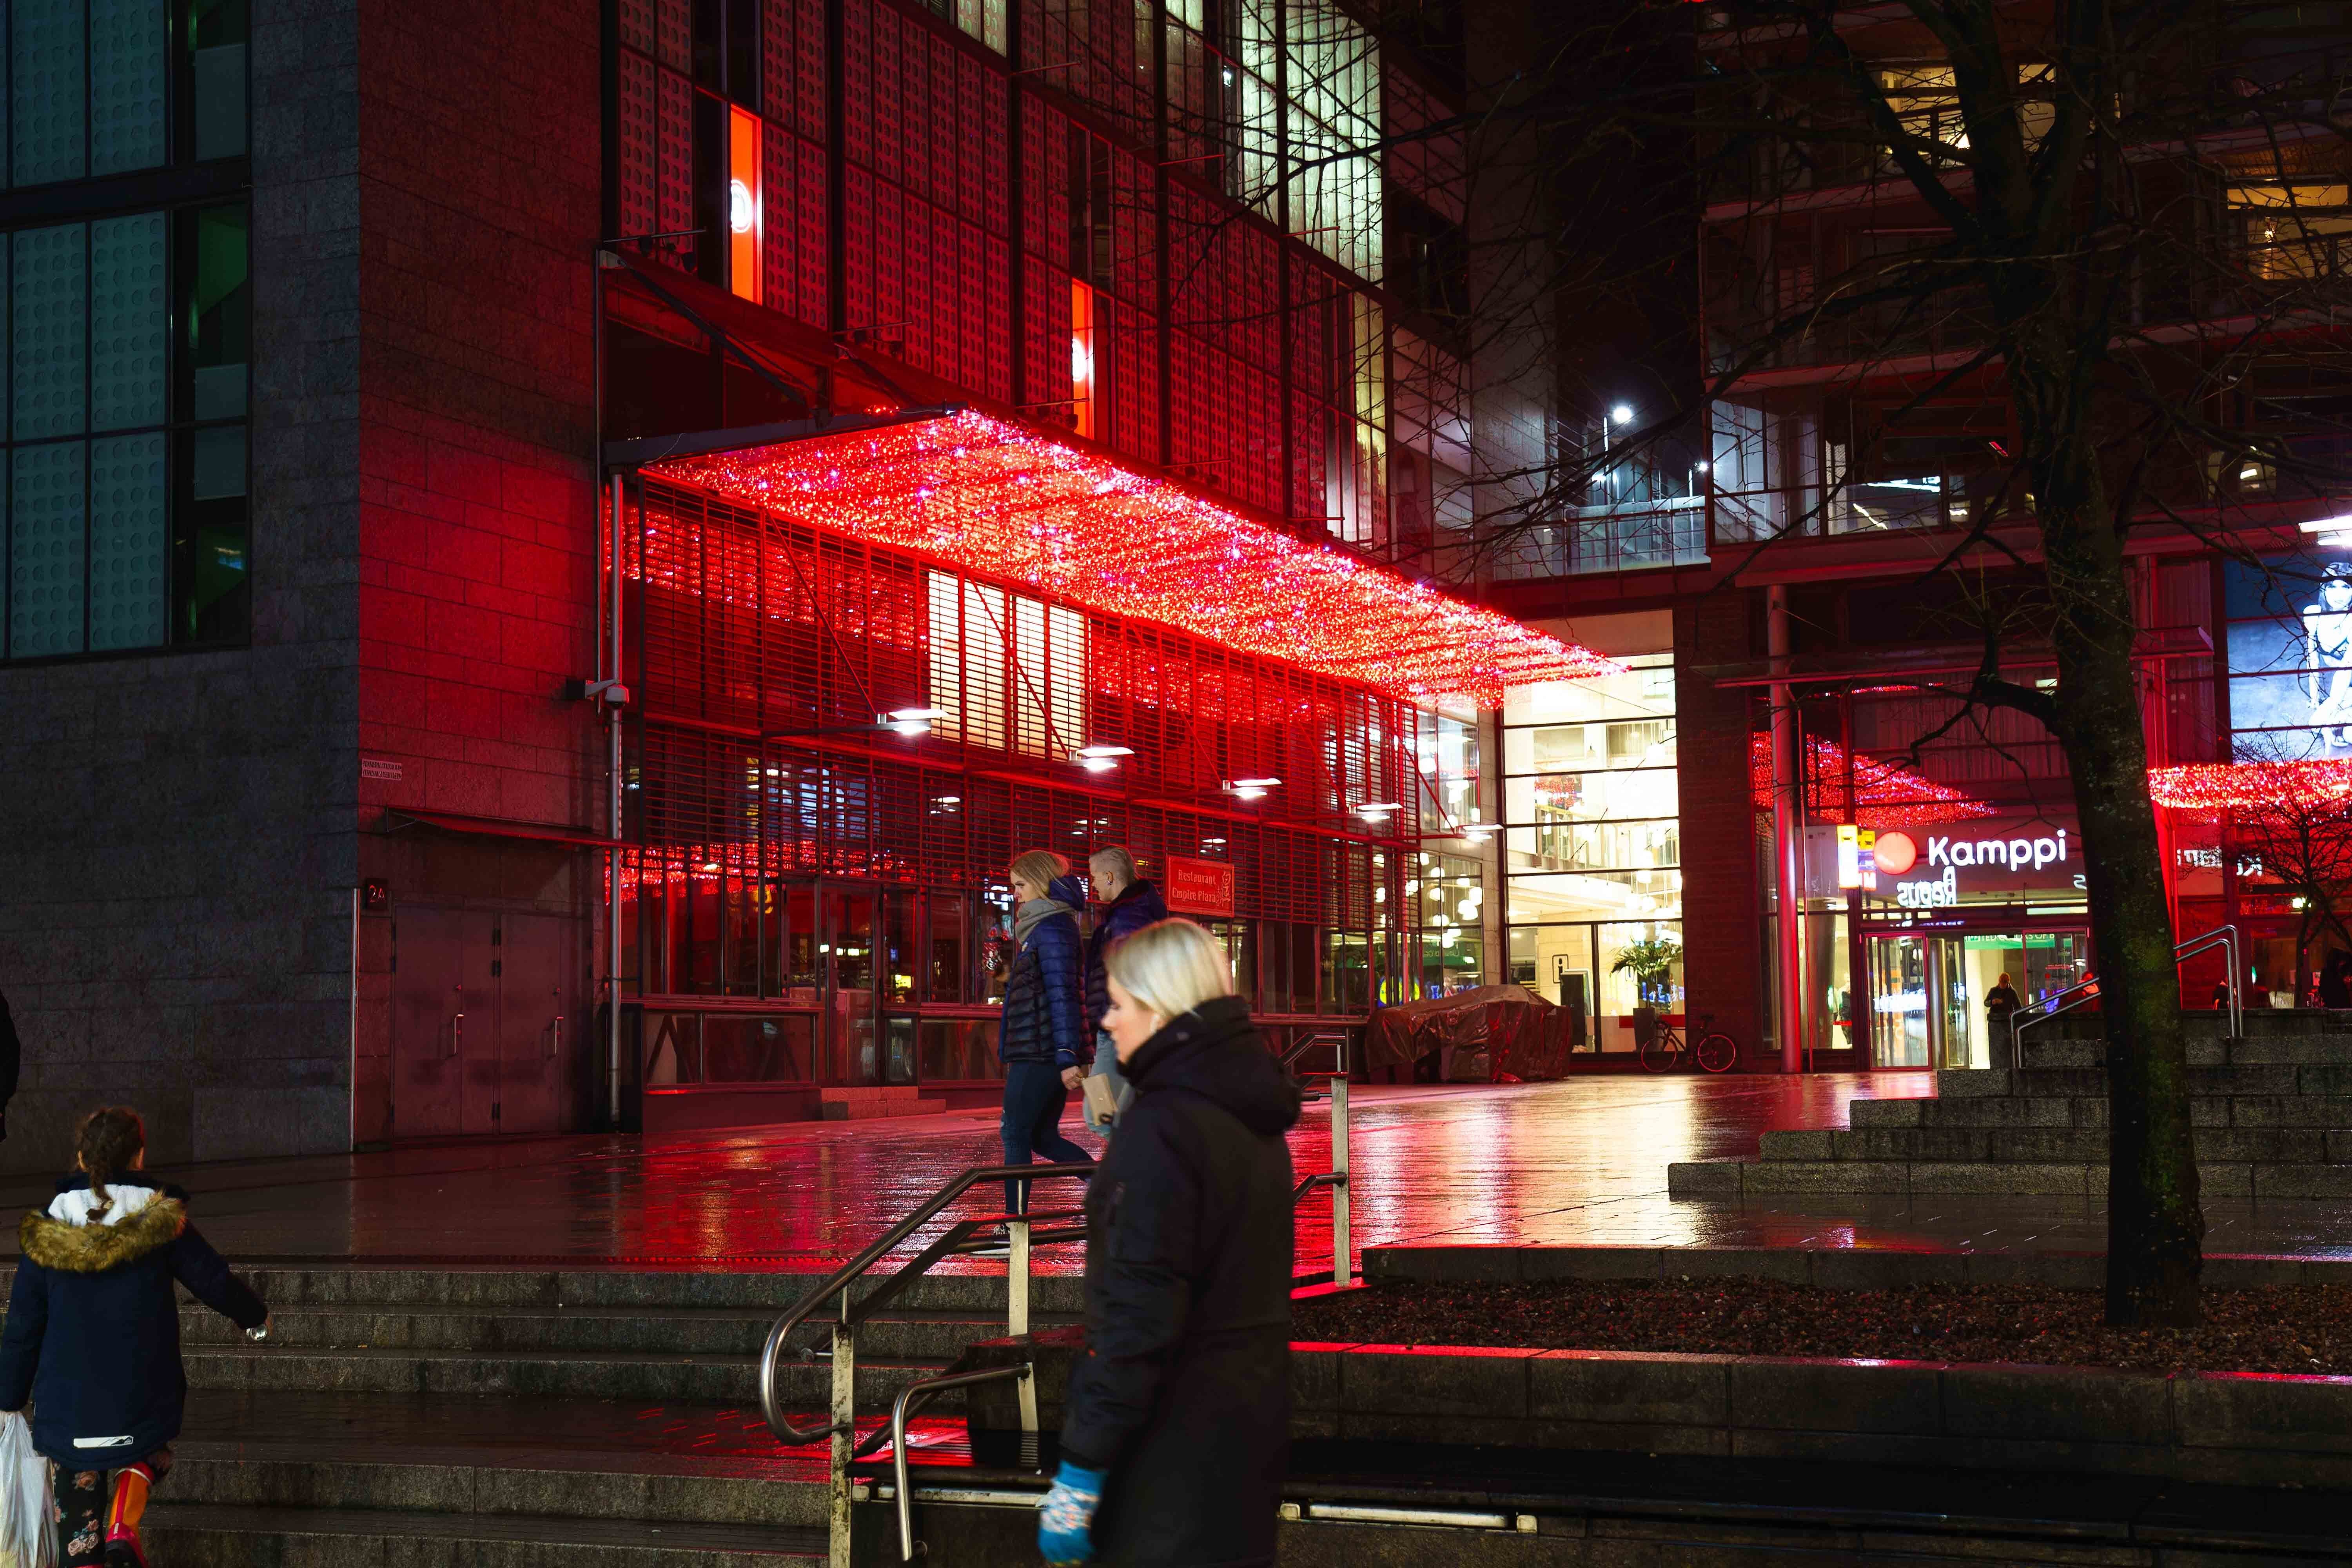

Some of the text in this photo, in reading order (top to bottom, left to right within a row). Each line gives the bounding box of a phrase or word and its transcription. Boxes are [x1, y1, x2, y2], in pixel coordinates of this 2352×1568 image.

[1929, 829, 2066, 871] Kamppi
[1178, 869, 1216, 885] Restaurant
[369, 885, 385, 903] 2A
[1172, 887, 1216, 903] Empire Plaza
